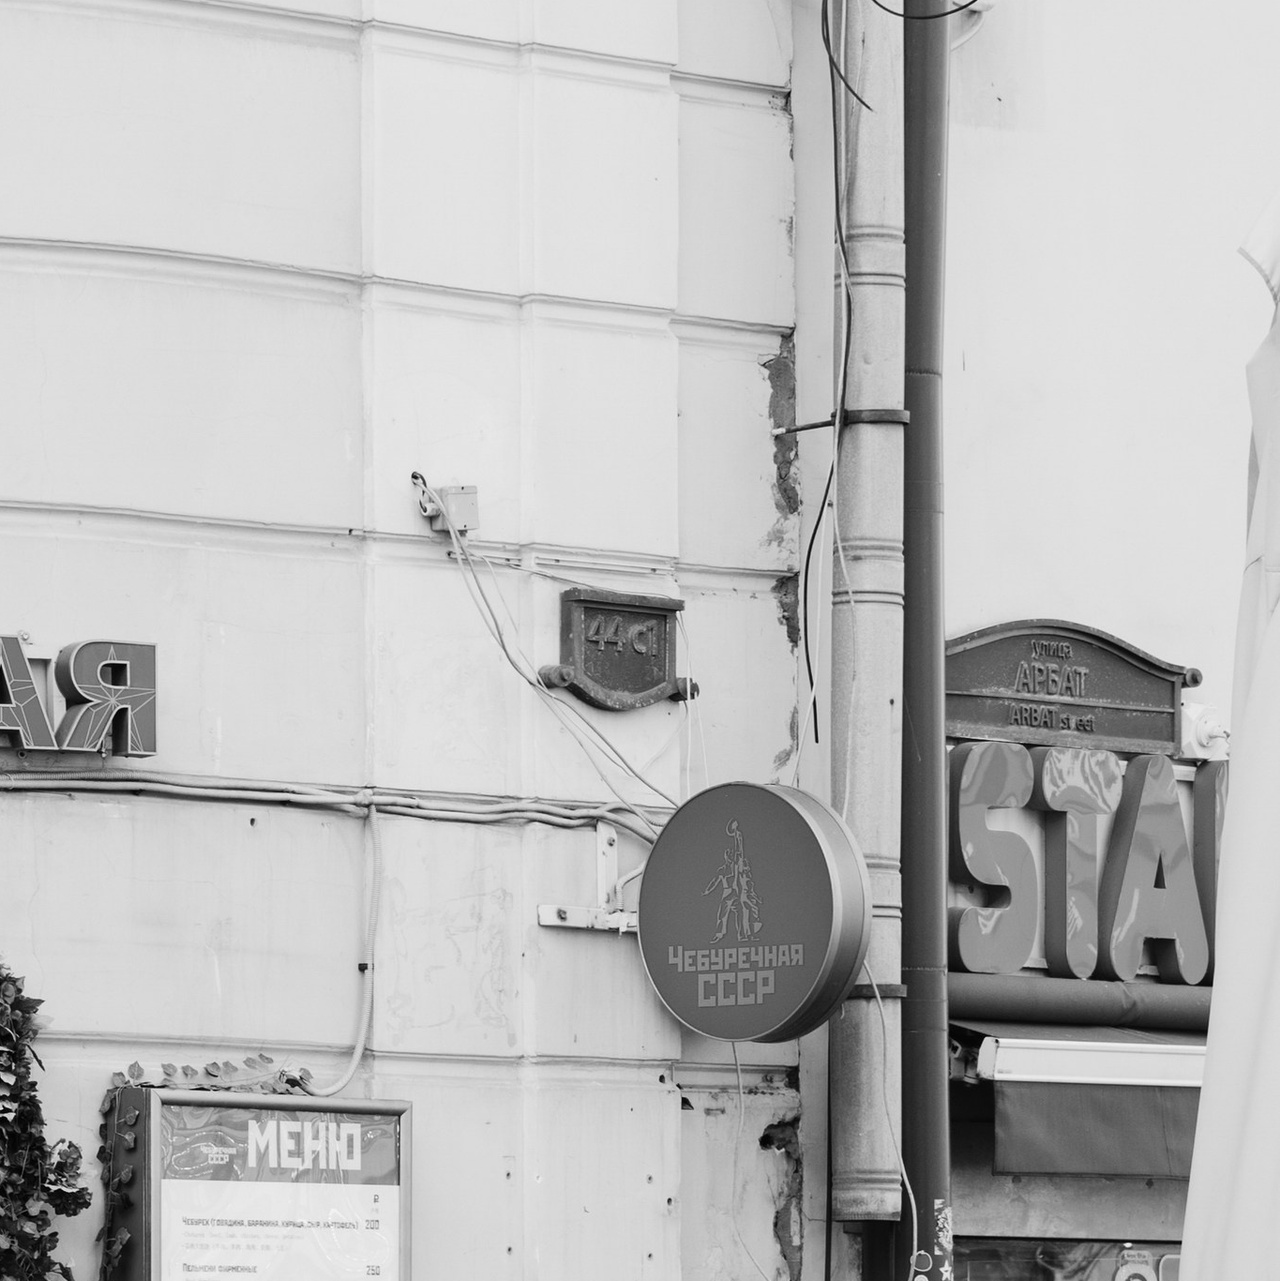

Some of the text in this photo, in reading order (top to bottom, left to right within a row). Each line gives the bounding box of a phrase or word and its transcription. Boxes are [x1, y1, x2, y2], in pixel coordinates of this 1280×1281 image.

[587, 614, 626, 651] 44
[1014, 660, 1089, 697] АРБАТ
[1009, 703, 1095, 732] ARBAT street
[949, 742, 1229, 986] STA
[668, 944, 804, 972] ЧЕБУРЕЧНАЯ
[697, 970, 775, 1008] СССР
[248, 1120, 362, 1171] МЕНЮ
[365, 1219, 380, 1230] 200
[366, 1265, 380, 1276] 250
